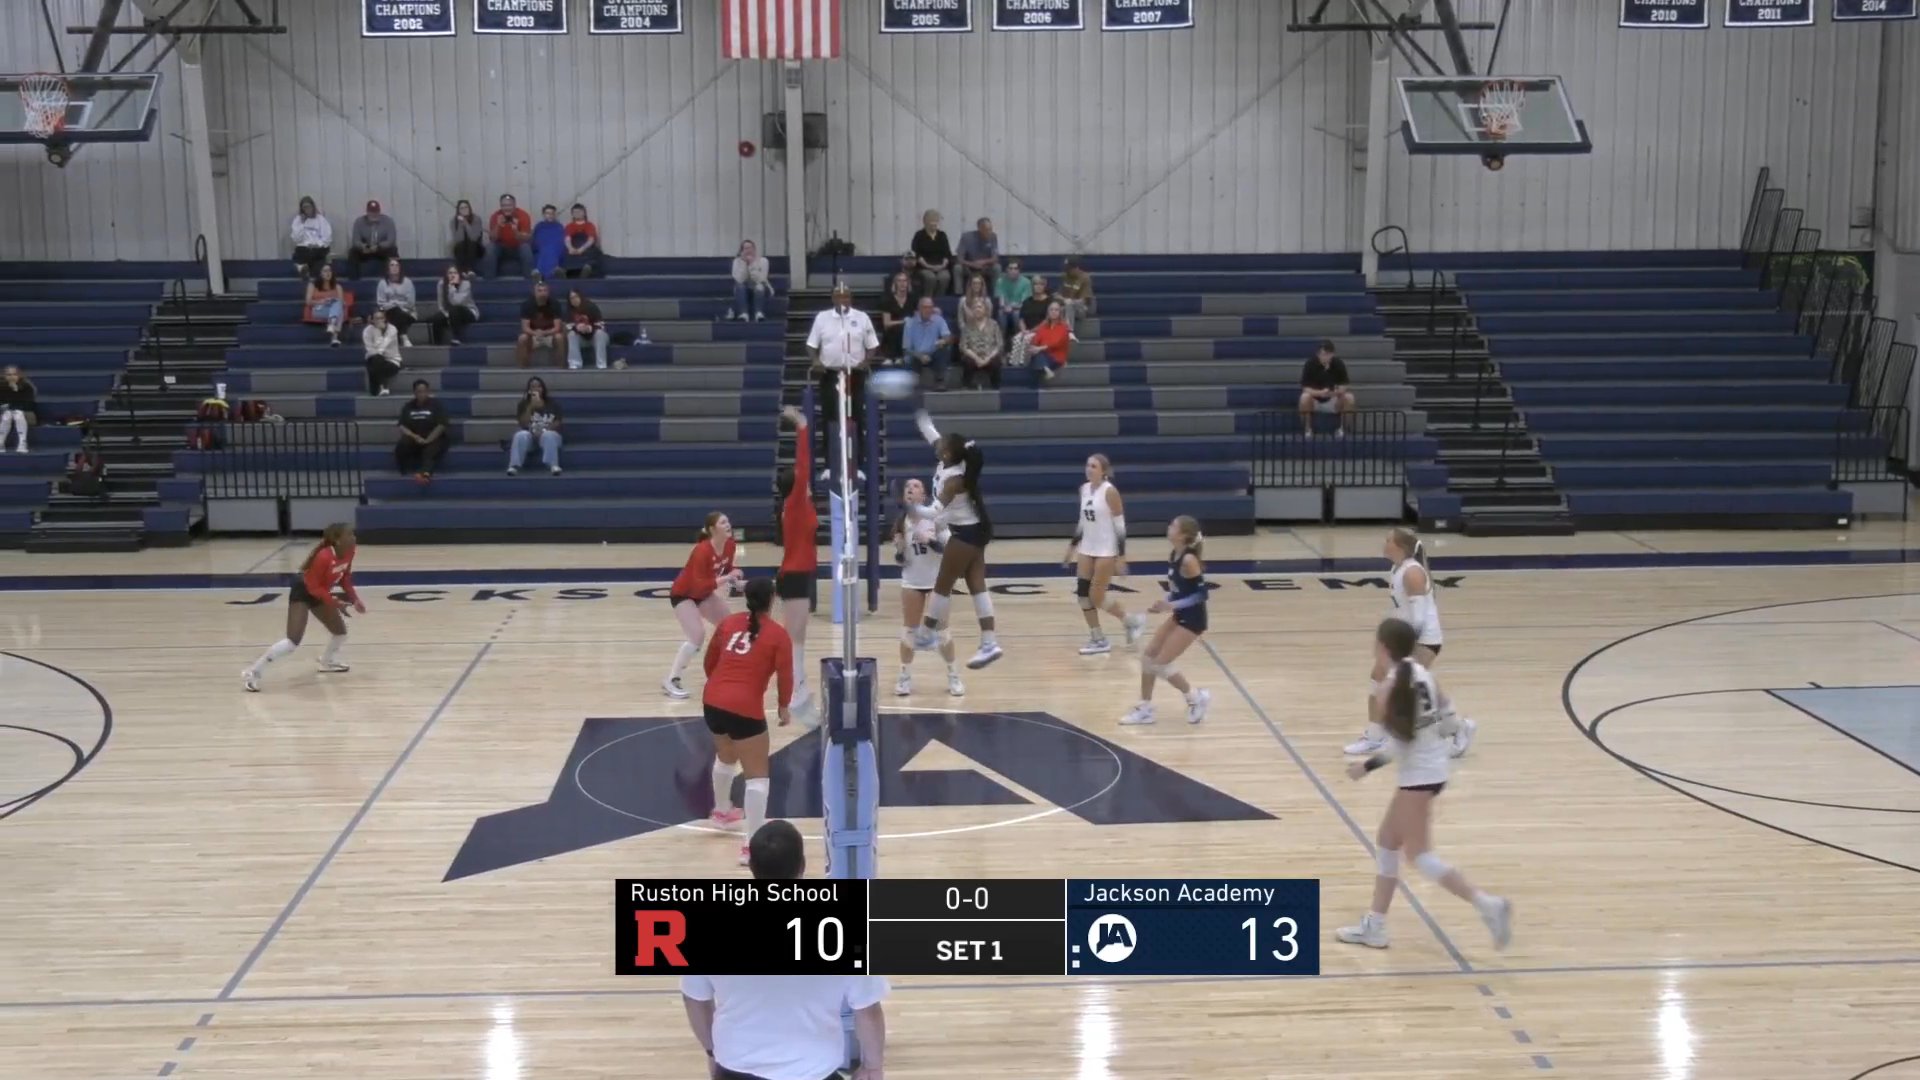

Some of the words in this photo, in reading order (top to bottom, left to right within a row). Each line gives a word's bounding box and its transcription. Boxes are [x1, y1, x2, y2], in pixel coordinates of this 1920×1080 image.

[375, 4, 441, 16] CHAMPIONS
[487, 0, 553, 11] CHAMPIONS
[603, 5, 668, 16] CHAMPIONS
[893, 0, 958, 10] CHAMPIONS
[1006, 0, 1070, 10] CHAMPIONS
[1862, 0, 1887, 11] 2014
[1024, 12, 1052, 24] 2006
[1133, 11, 1161, 23] 2007
[1651, 9, 1677, 21] 2010
[1758, 8, 1781, 19] 2011
[393, 19, 423, 30] 2002
[507, 16, 534, 27] 2003
[621, 17, 650, 28] 2004
[912, 14, 940, 26] 2005
